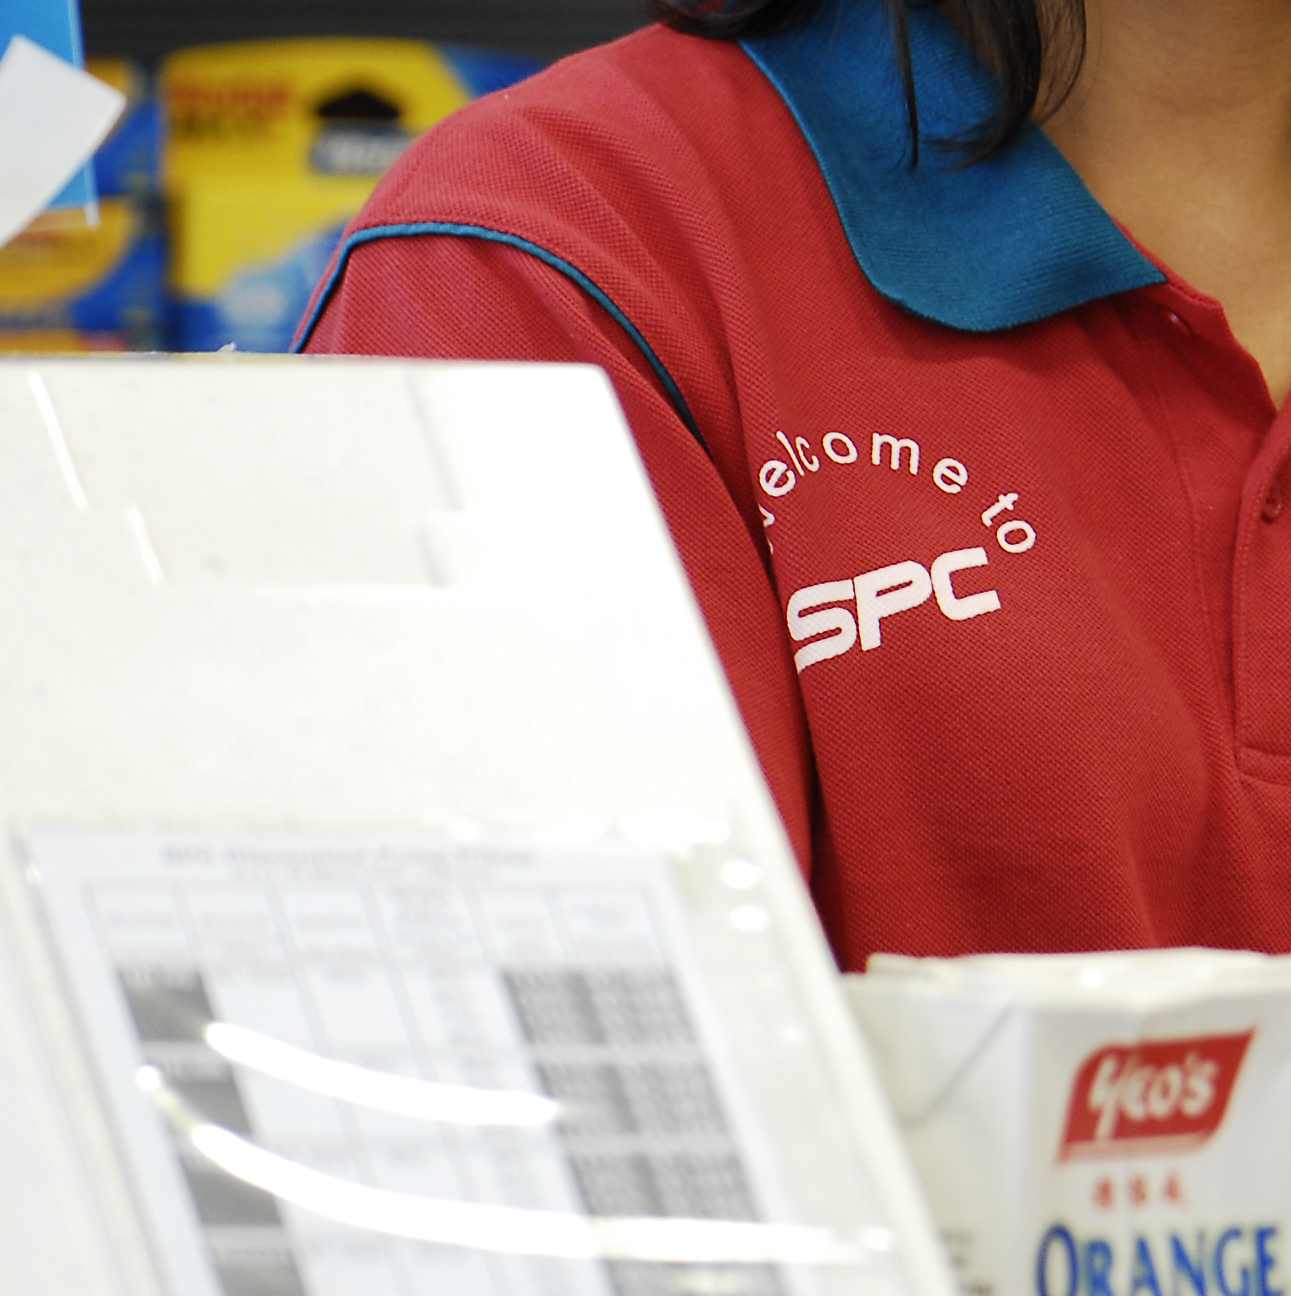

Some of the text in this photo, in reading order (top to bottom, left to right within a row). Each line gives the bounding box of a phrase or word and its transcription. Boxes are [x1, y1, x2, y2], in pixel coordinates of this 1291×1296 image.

[981, 492, 1036, 553] to
[787, 547, 1001, 673] SPC
[1036, 1224, 1286, 1296] ORANGE
